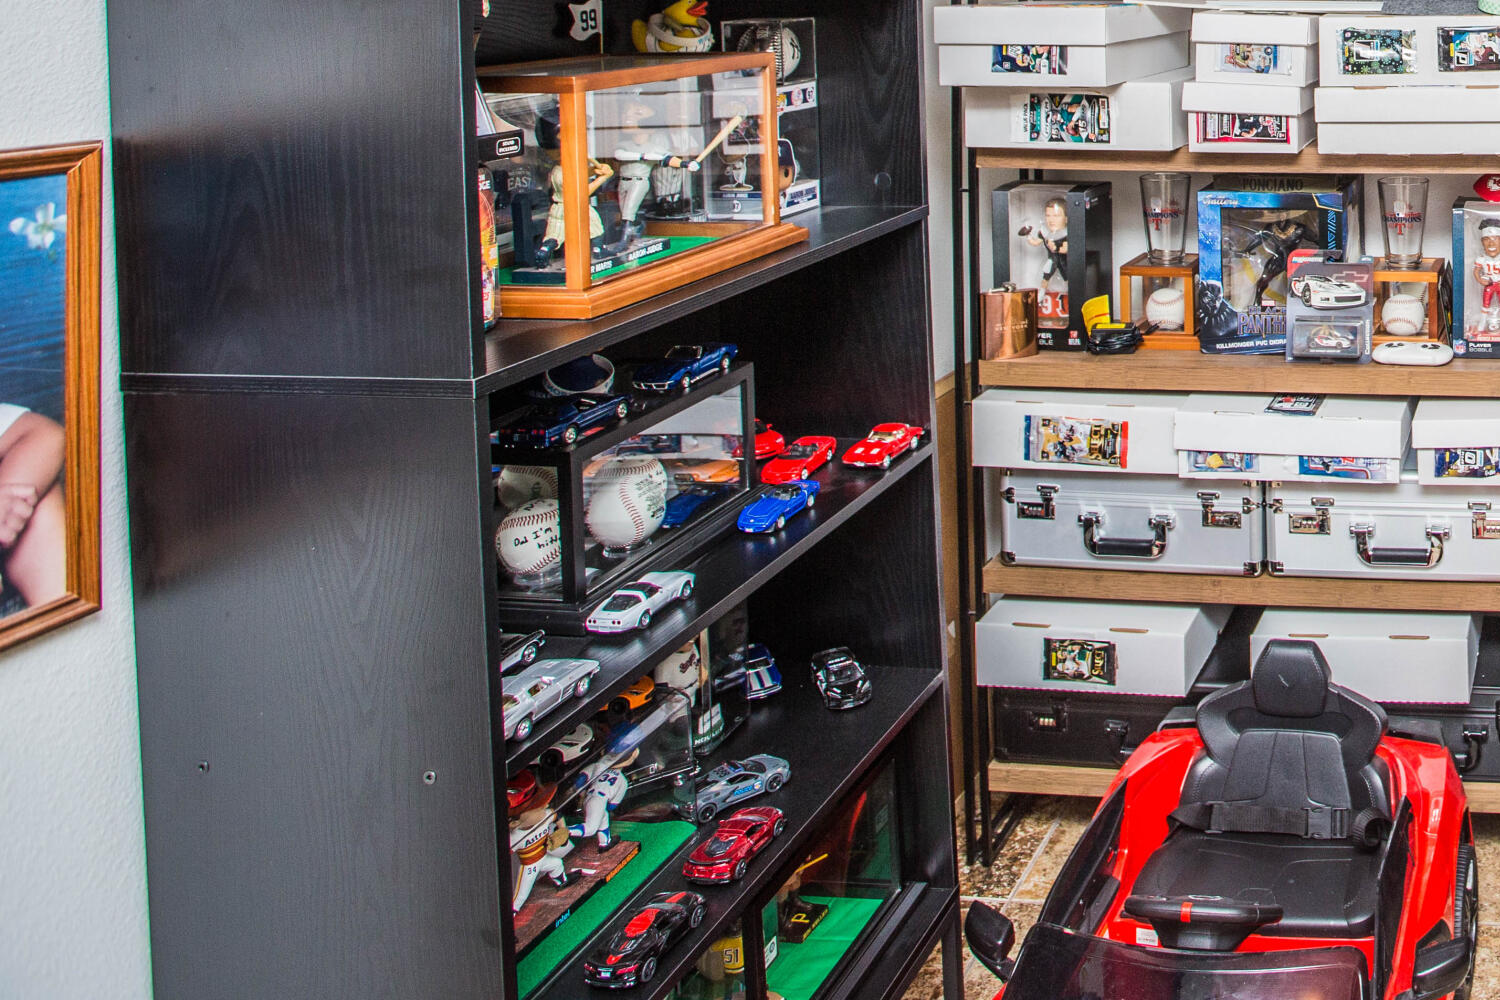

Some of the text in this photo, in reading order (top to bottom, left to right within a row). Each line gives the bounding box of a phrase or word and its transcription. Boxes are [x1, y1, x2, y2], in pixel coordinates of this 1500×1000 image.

[580, 9, 599, 32] 99
[1242, 177, 1304, 191] PONCIANO
[1486, 263, 1500, 276] 15
[1237, 313, 1287, 335] PANTH
[1216, 340, 1255, 349] KILLMONGER
[513, 526, 553, 548] Dad I'm
[598, 773, 618, 787] 34
[733, 784, 754, 796] POLICE
[555, 908, 571, 928] intel
[791, 913, 810, 923] P
[723, 949, 739, 964] 51
